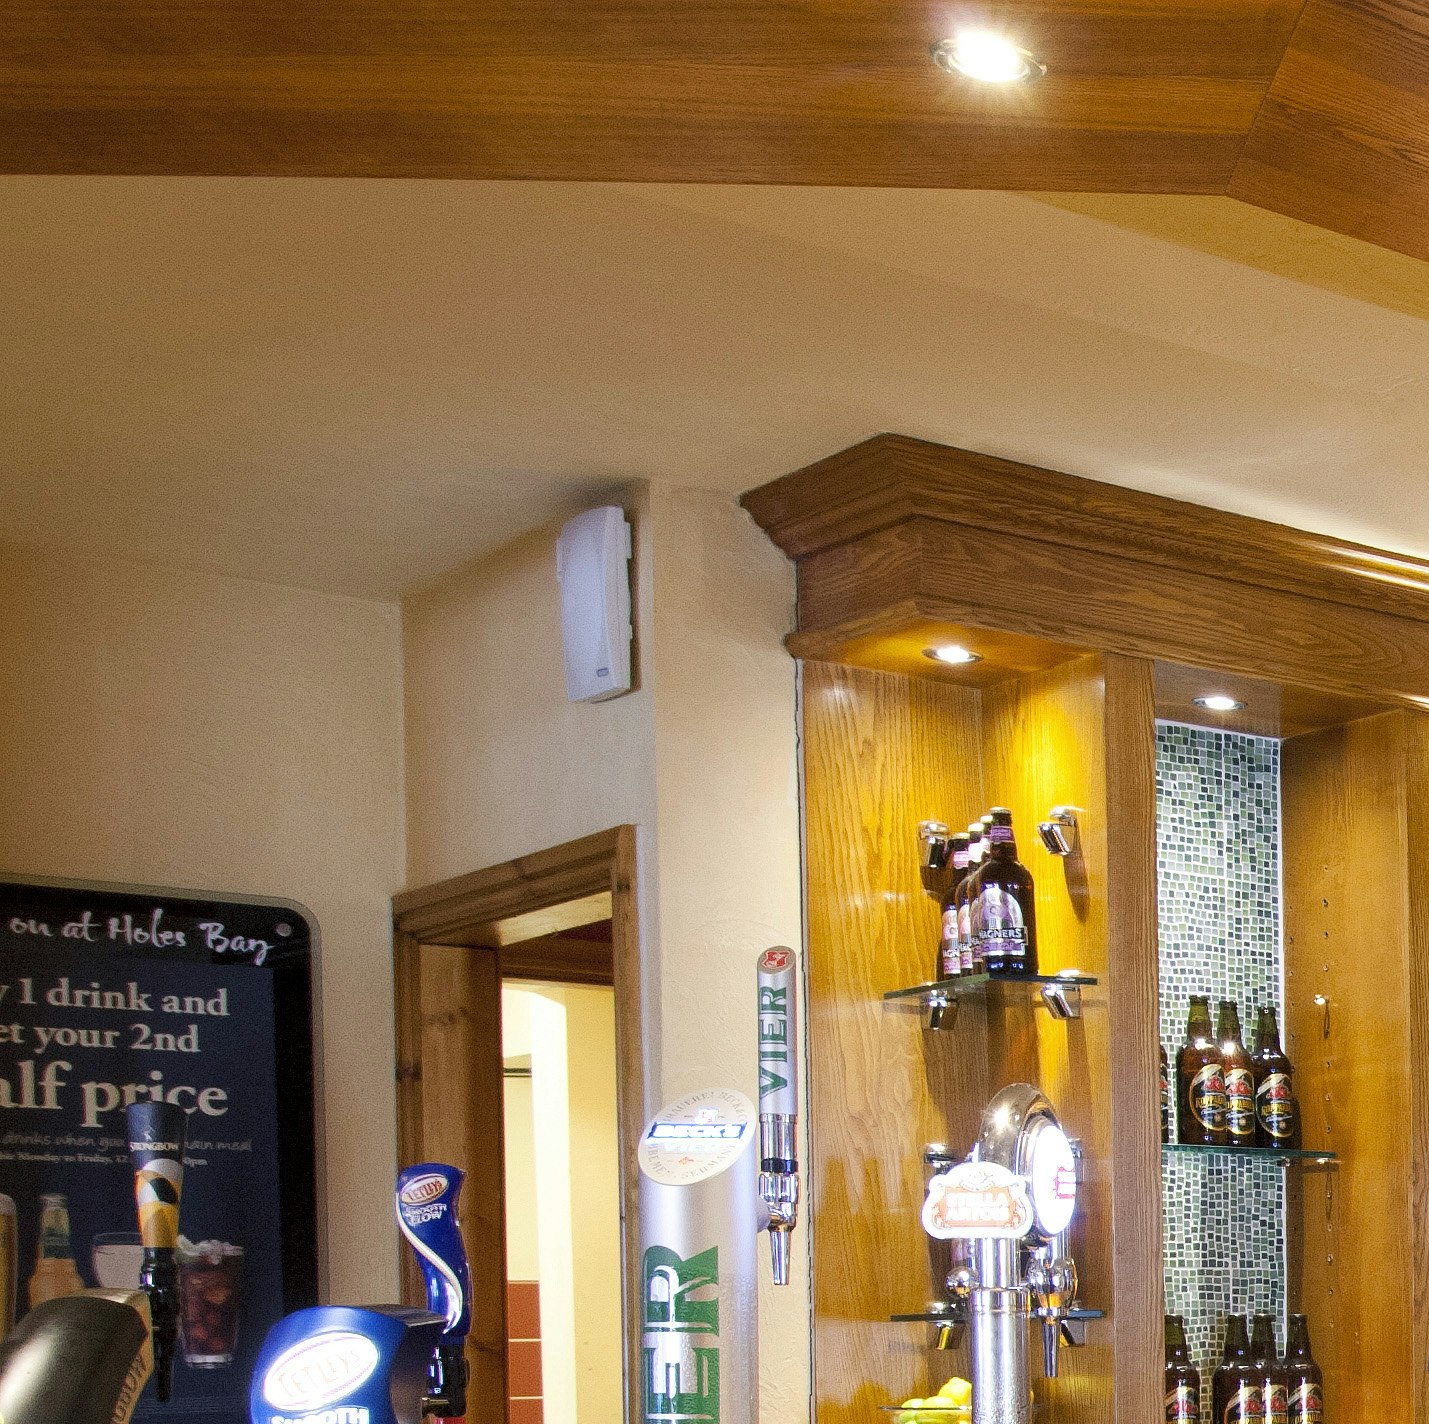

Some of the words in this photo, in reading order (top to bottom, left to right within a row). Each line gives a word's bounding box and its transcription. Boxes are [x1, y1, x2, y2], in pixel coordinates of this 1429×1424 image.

[60, 910, 100, 942] at
[106, 908, 188, 948] Holes
[197, 922, 275, 966] Bay
[19, 978, 36, 1004] 1
[47, 977, 154, 1011] drink
[162, 988, 230, 1016] and
[33, 1026, 120, 1054] your
[129, 1023, 202, 1052] 2nd
[759, 986, 788, 1101] VIER
[81, 1070, 229, 1128] price
